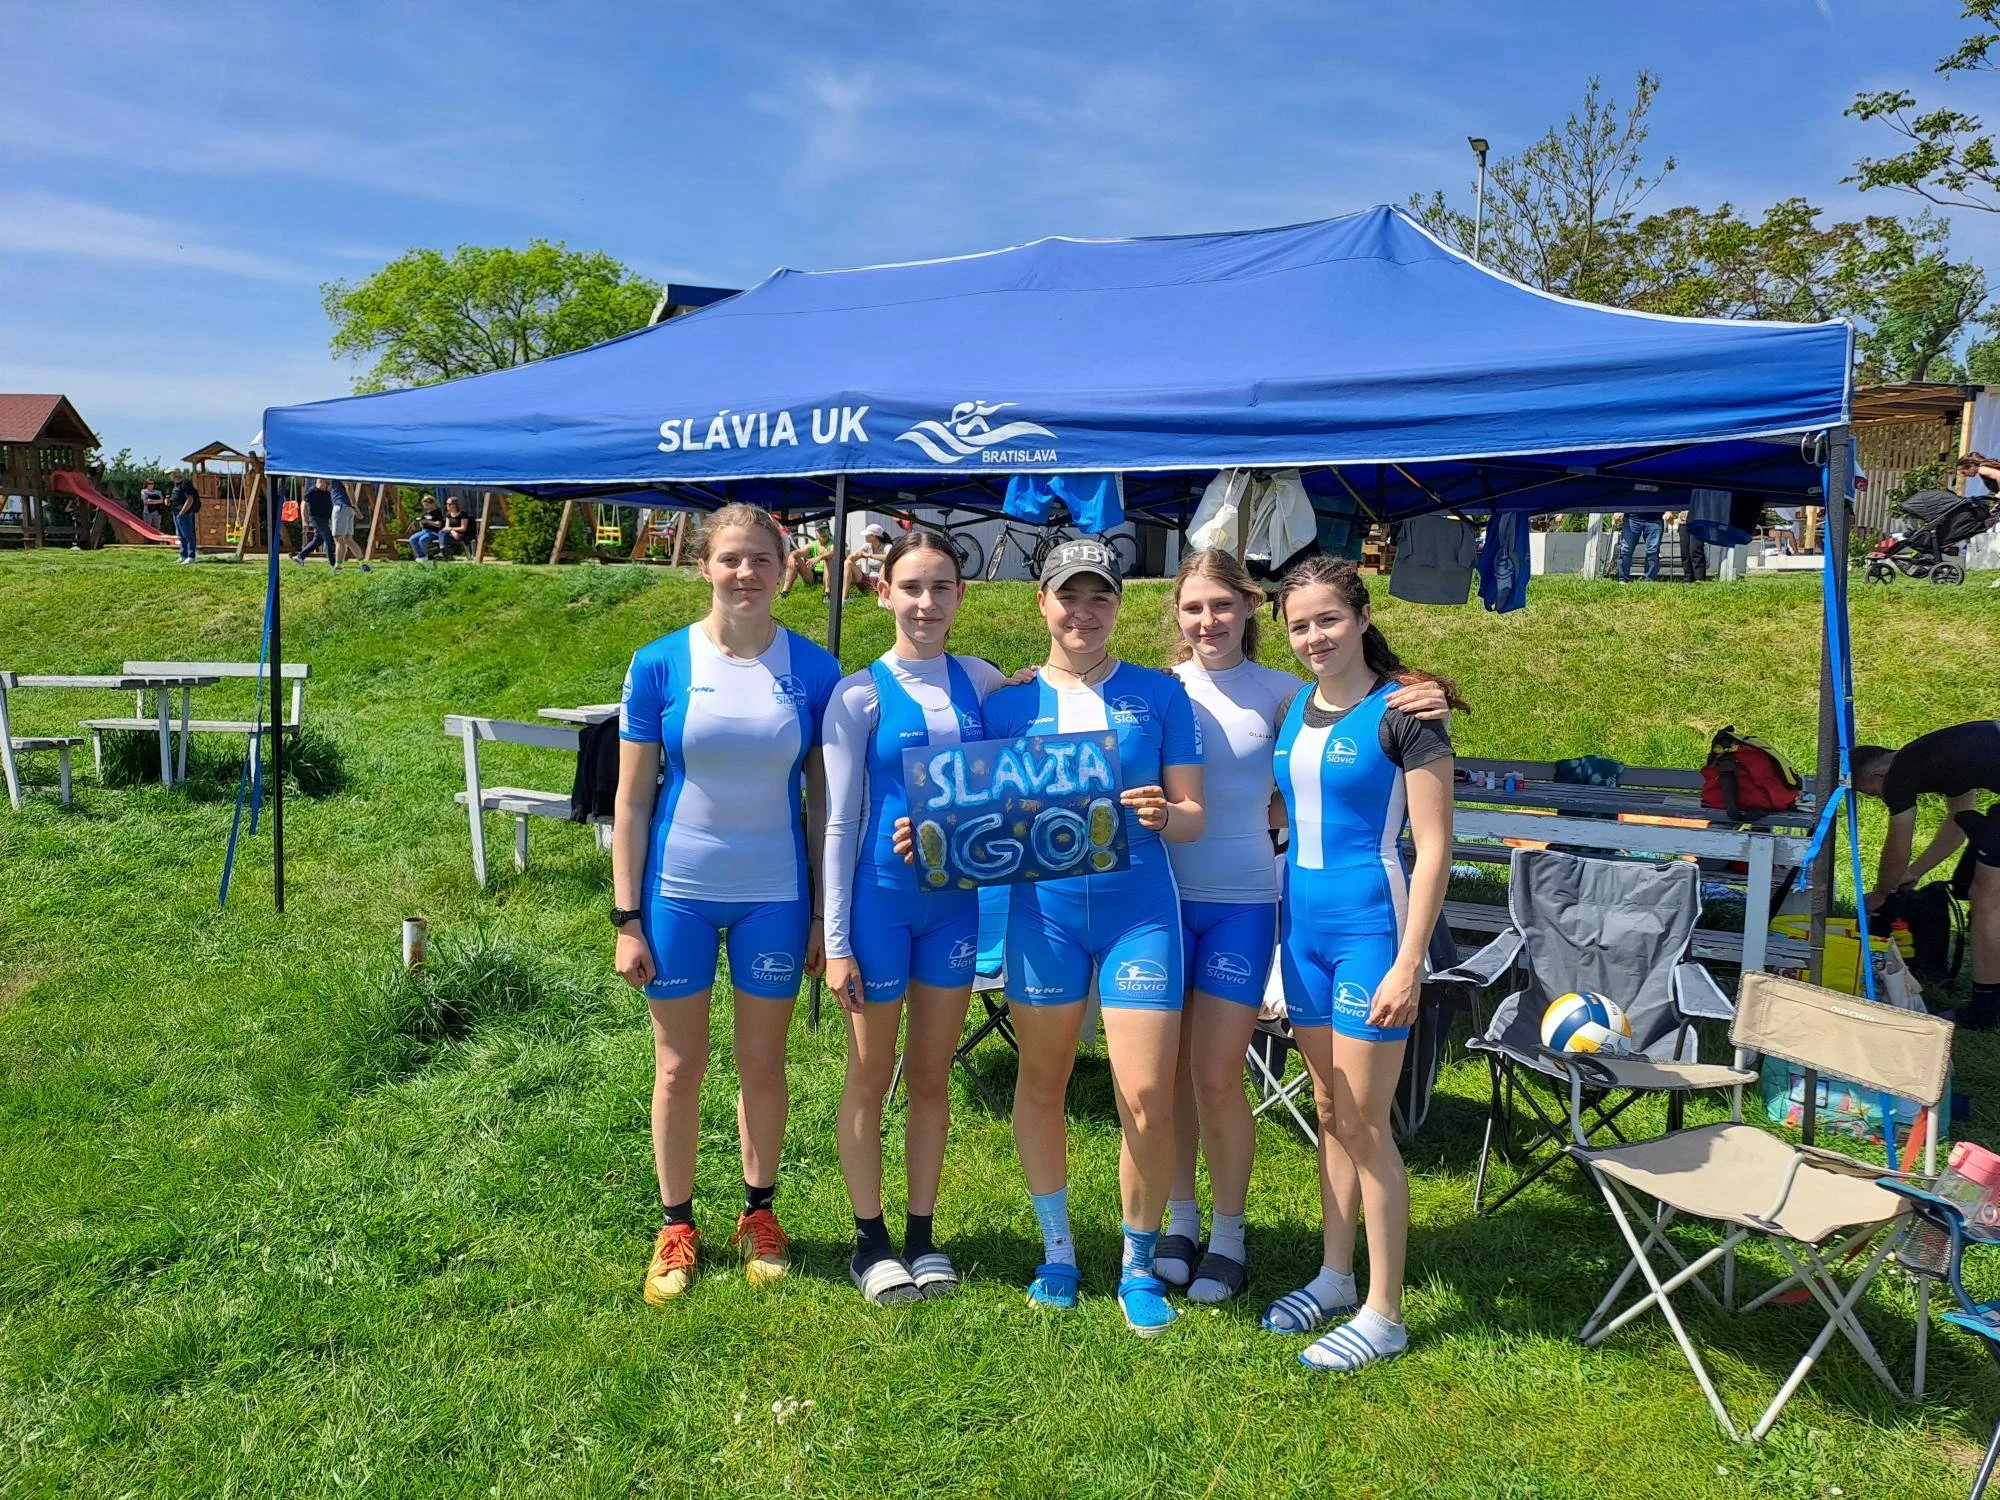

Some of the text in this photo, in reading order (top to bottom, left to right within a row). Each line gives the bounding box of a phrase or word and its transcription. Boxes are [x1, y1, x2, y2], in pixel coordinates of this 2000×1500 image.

[656, 406, 871, 453] SLÁVIA UK
[981, 448, 1058, 463] BRATISLAVA
[1060, 545, 1112, 570] FBI
[925, 739, 1114, 810] SLÁVIA
[1117, 980, 1166, 991] Slávia
